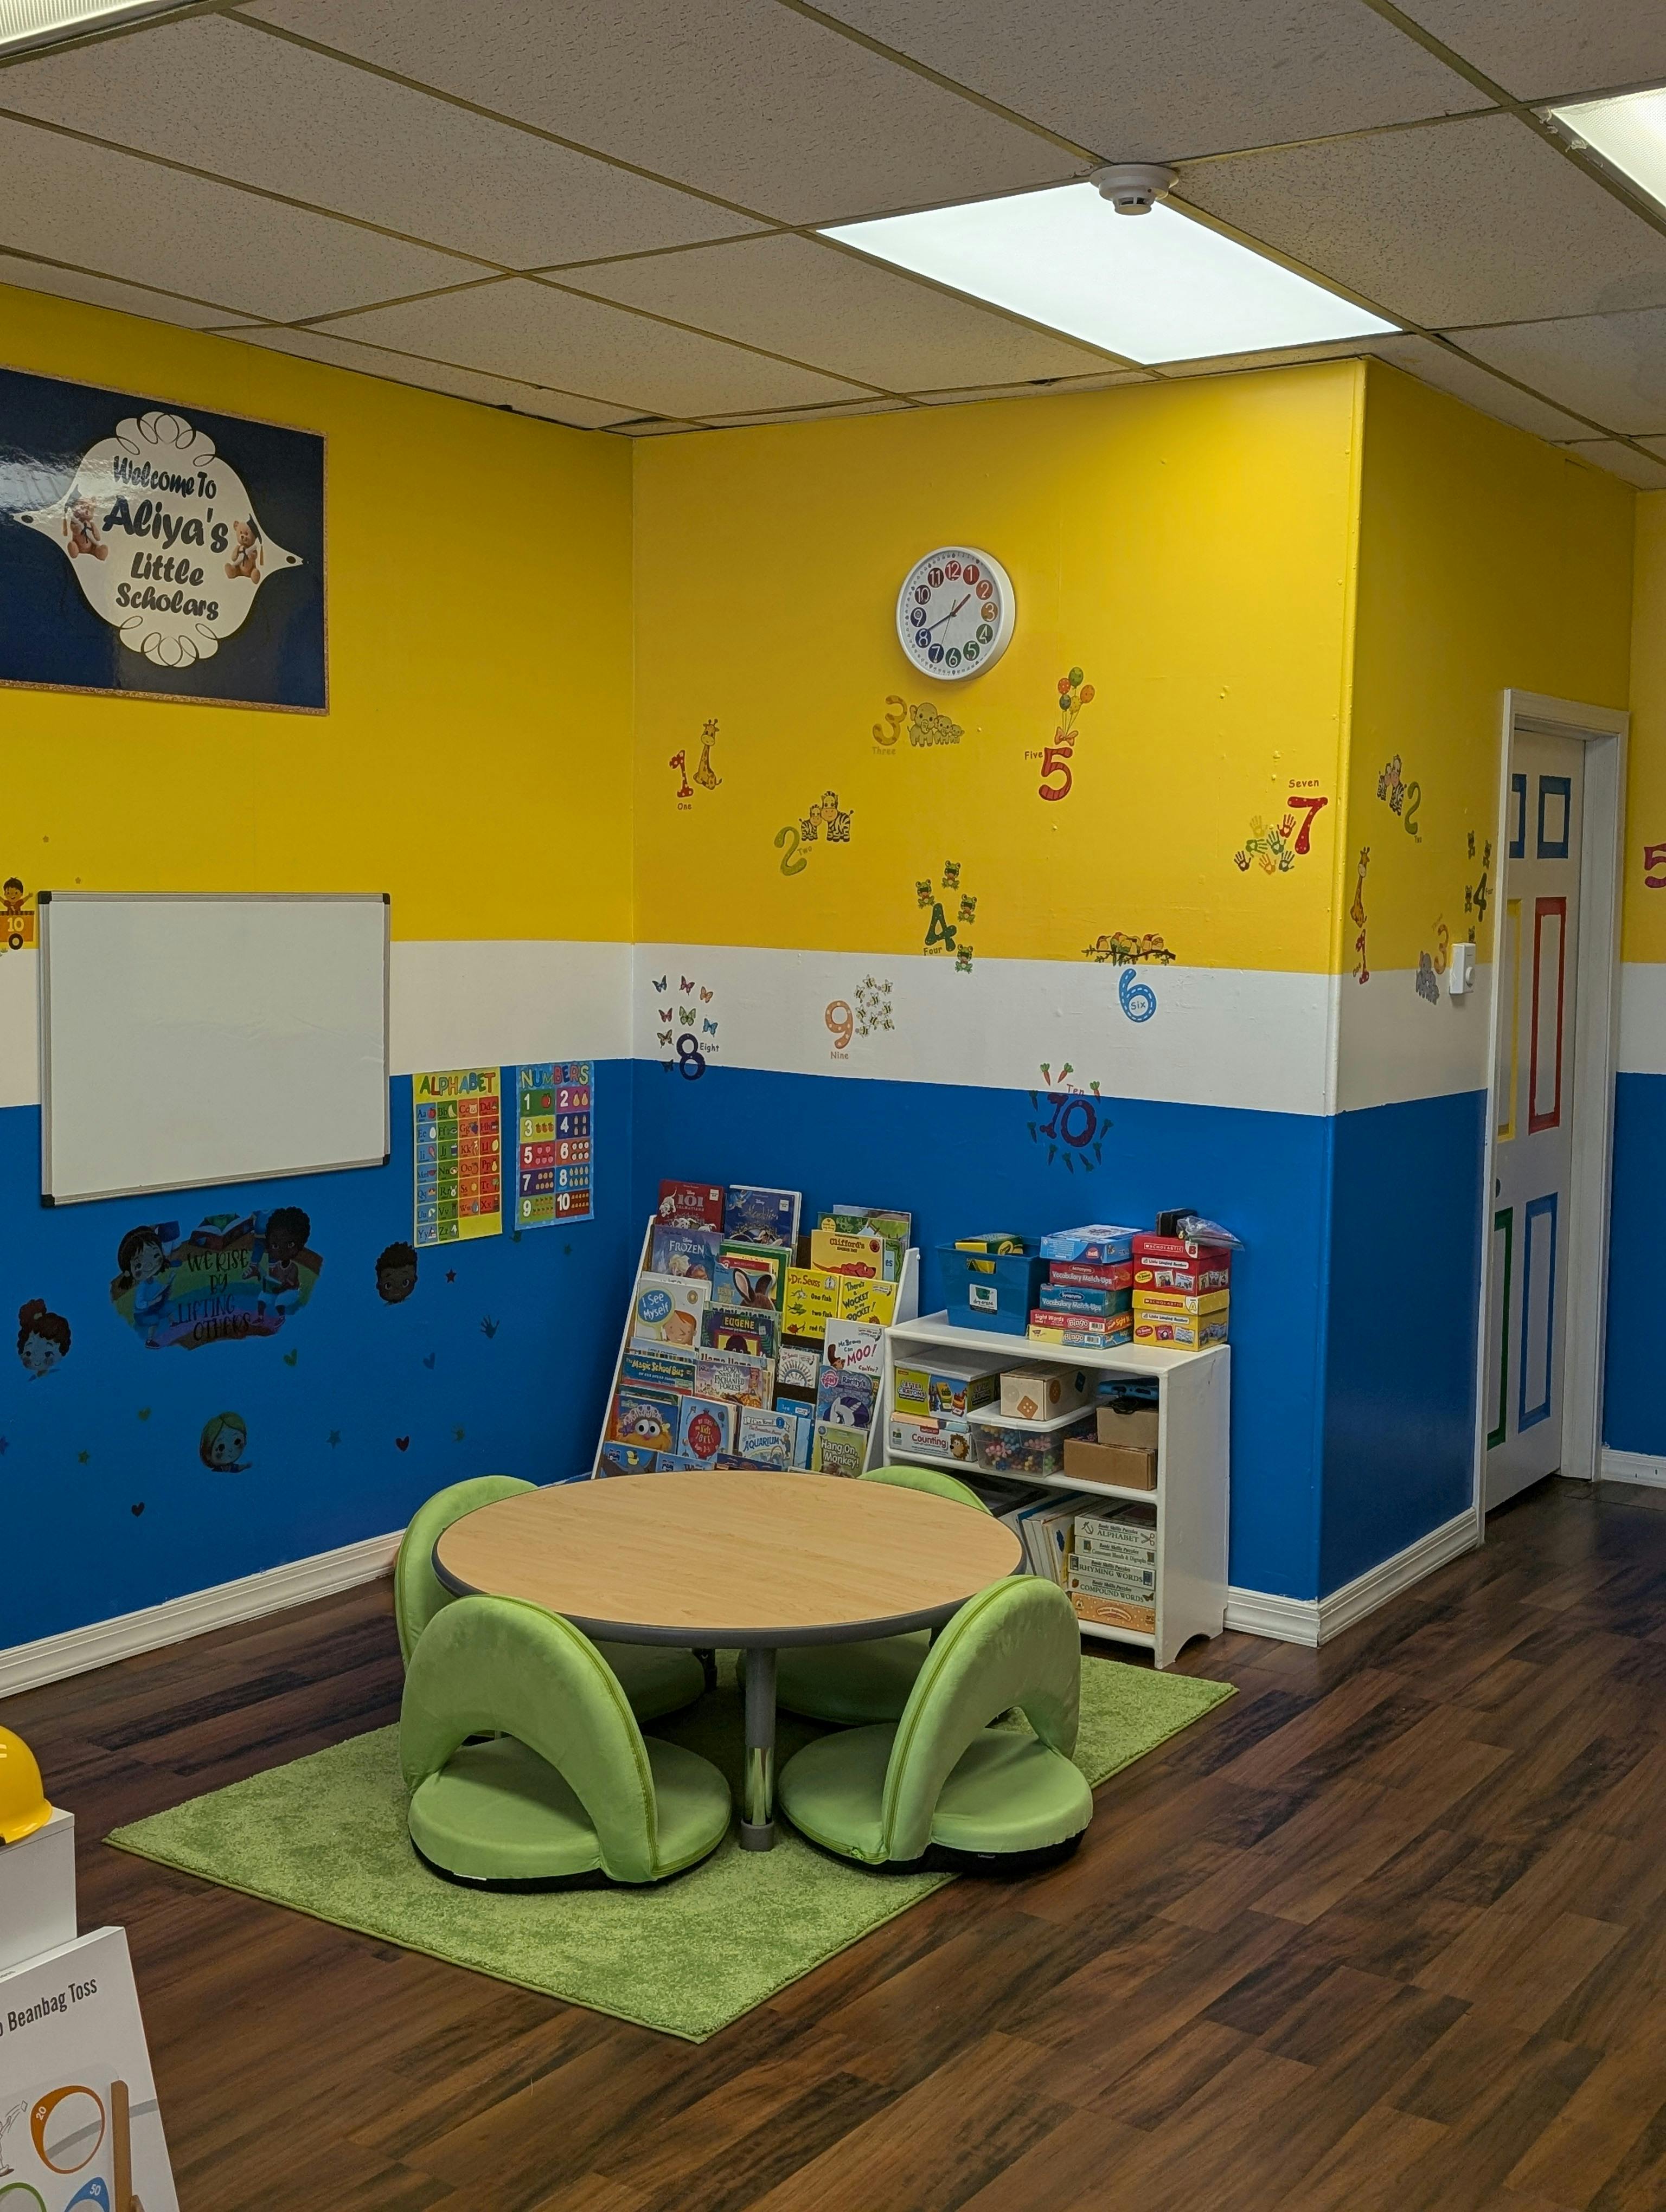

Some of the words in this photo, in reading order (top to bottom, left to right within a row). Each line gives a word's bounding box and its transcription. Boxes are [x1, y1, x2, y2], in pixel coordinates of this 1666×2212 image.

[113, 455, 194, 498] Welcome
[197, 471, 216, 499] To
[102, 496, 229, 553] Aliya's
[131, 552, 204, 587] Little
[930, 570, 941, 586] 11
[946, 562, 960, 578] 12
[967, 566, 973, 582] 1
[917, 587, 930, 603] 10
[981, 582, 989, 599] 2
[116, 582, 219, 621] Scholars
[914, 610, 924, 627] 9
[985, 603, 995, 621] 3
[919, 629, 928, 646] 8
[979, 625, 988, 644] 4
[931, 646, 940, 663] 7
[949, 650, 958, 666] 6
[966, 642, 976, 660] 5
[872, 695, 907, 745] 3
[872, 747, 896, 755] Three
[1024, 750, 1043, 761] Five
[669, 750, 694, 798] 1
[1038, 747, 1073, 801] 5
[1288, 777, 1319, 788] Seven
[1404, 781, 1421, 835] 2
[1287, 795, 1328, 855] 7
[774, 826, 807, 876] 2
[797, 845, 812, 856] Two
[1473, 872, 1487, 922] 4
[7, 917, 24, 932] 10
[925, 903, 957, 951] 4
[923, 946, 943, 956] Four
[1355, 929, 1369, 985] 1
[1434, 924, 1449, 975] 3
[1119, 968, 1157, 1023] 6
[825, 1000, 853, 1050] 9
[700, 1042, 720, 1053] Eight
[830, 1051, 849, 1060] Nine
[676, 1033, 705, 1081] 8
[419, 1072, 496, 1096] ALPHABET
[521, 1064, 589, 1089] NUMBERS
[1066, 1084, 1085, 1096] Ten
[524, 1093, 530, 1110] 1
[560, 1090, 568, 1108] 2
[524, 1119, 533, 1137] 3
[560, 1116, 569, 1133] 4
[1040, 1092, 1097, 1147] 10
[524, 1147, 533, 1163] 5
[560, 1142, 568, 1159] 6
[522, 1174, 531, 1191] 7
[559, 1169, 567, 1186] 8
[523, 1200, 531, 1217] 9
[557, 1193, 570, 1211] 10
[677, 1194, 704, 1207] 101
[669, 1240, 704, 1255] FROZEN
[829, 1238, 865, 1250] Clifford's
[1188, 1245, 1196, 1255] B
[187, 1251, 213, 1272] WE
[216, 1249, 249, 1272] RISE
[791, 1274, 802, 1284] Dr.
[802, 1275, 821, 1288] Seuss
[1052, 1270, 1082, 1283] Vocabulary
[1082, 1275, 1112, 1284] Match-Ups
[648, 1293, 664, 1306] See
[842, 1291, 869, 1309] WOCKET
[1042, 1297, 1072, 1309] Vocabulary
[1072, 1301, 1102, 1312] Match-Ups
[1149, 1299, 1182, 1307] SCHOLASTIC
[1189, 1301, 1197, 1311] A
[178, 1294, 235, 1324] LIFTING
[643, 1302, 669, 1320] Myself
[194, 1312, 251, 1341] OTHERS
[725, 1316, 754, 1329] EUGENE
[1068, 1318, 1088, 1328] Bingo
[1064, 1332, 1084, 1342] Bingo
[847, 1344, 877, 1366] MOO!
[632, 1360, 651, 1371] Magic
[651, 1361, 671, 1374] School
[671, 1366, 684, 1377] Bus
[842, 1377, 866, 1388] Rarity's
[898, 1387, 926, 1397] CRAYONS
[743, 1436, 779, 1452] AQUARIUM
[821, 1438, 843, 1455] Hang
[844, 1444, 858, 1457] On,
[912, 1433, 946, 1448] Counting
[824, 1451, 860, 1469] Monkey!
[1097, 1529, 1139, 1542] ALPHABET
[1079, 1564, 1114, 1577] RHYMING
[1116, 1571, 1143, 1583] WORDS
[1080, 1584, 1119, 1597] COMPOUND
[1120, 1592, 1144, 1603] WORDS
[8, 1992, 67, 2031] Beanbag
[68, 1979, 97, 2003] Toss
[36, 2106, 47, 2121] 20
[89, 2184, 101, 2196] 50
